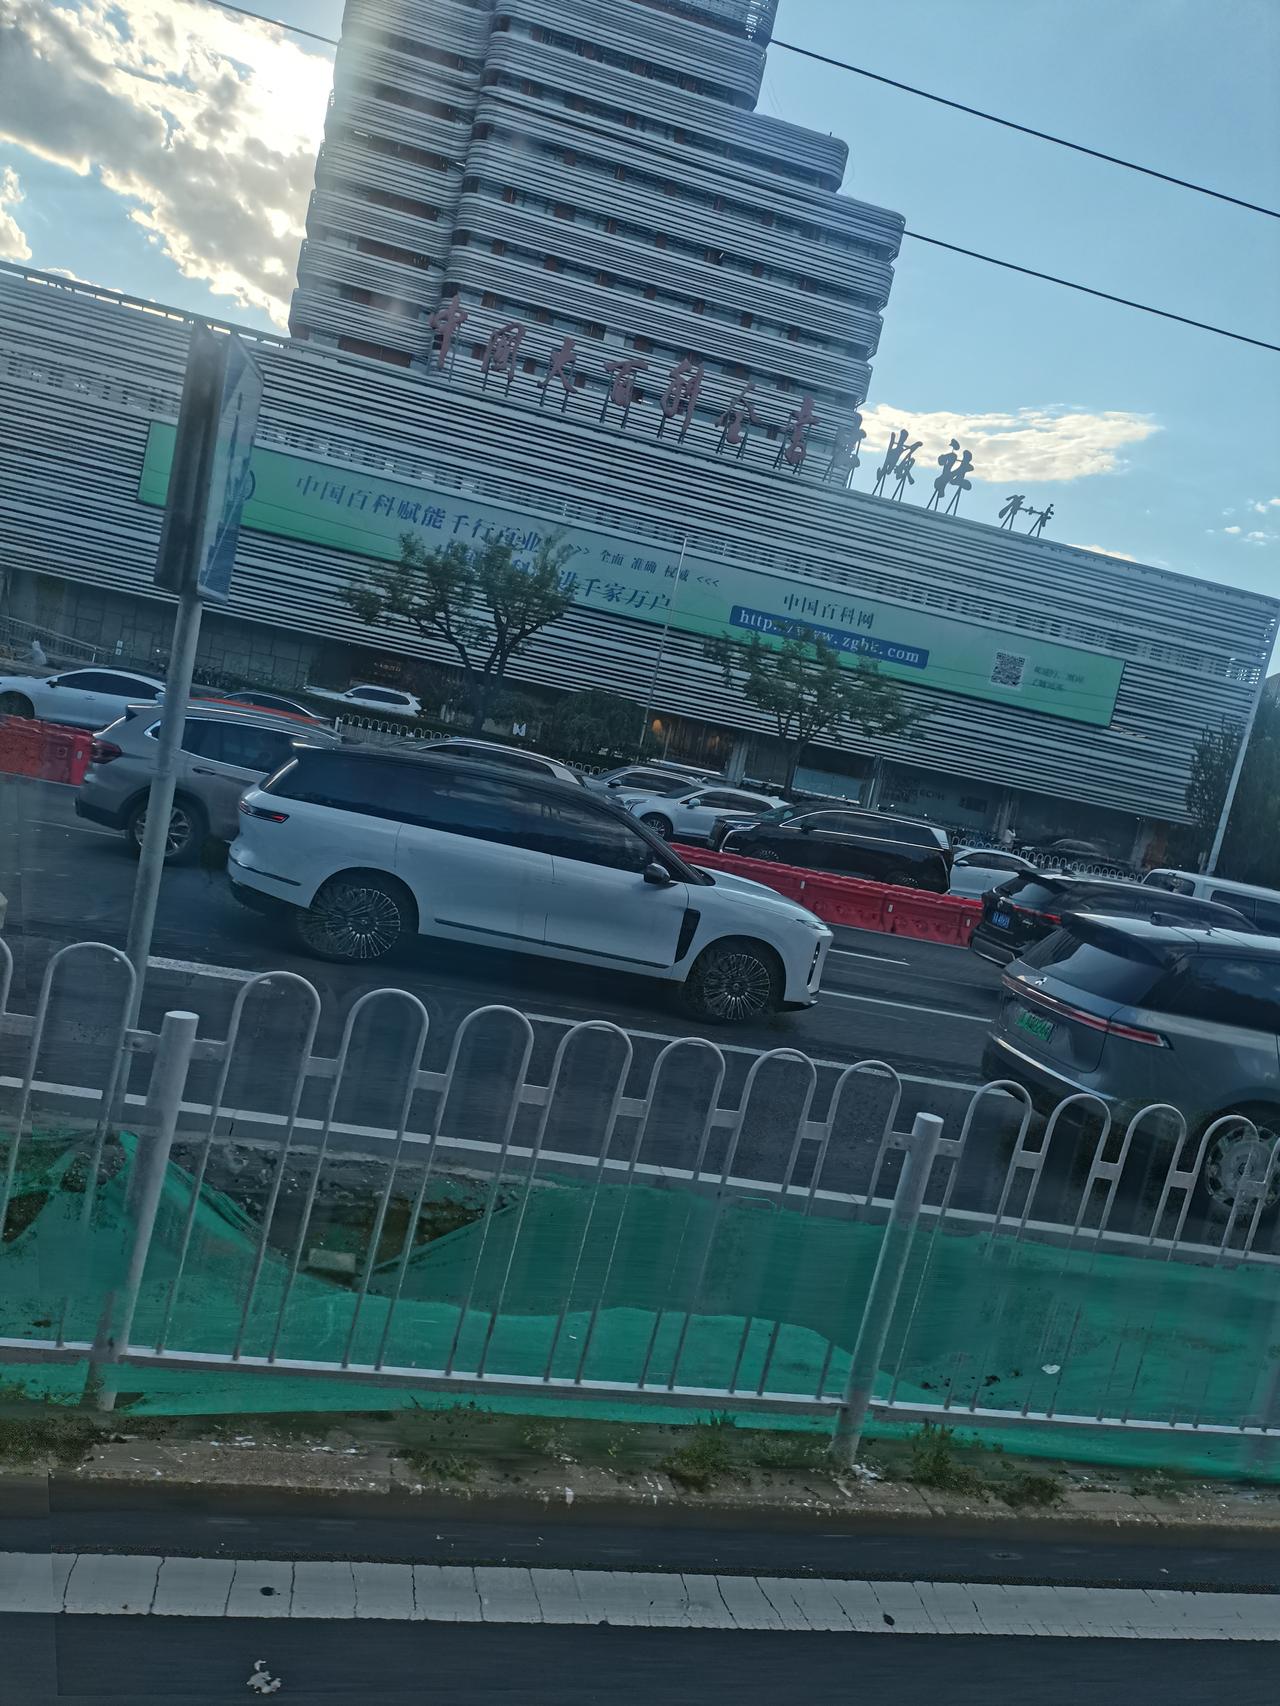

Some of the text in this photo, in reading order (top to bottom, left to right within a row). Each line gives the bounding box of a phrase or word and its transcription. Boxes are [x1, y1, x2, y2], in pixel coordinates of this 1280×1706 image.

[297, 474, 542, 553] 中国百科赋能千行百业
[600, 549, 624, 566] 全面
[631, 557, 657, 574] 准确
[784, 593, 875, 629] 中国百科网
